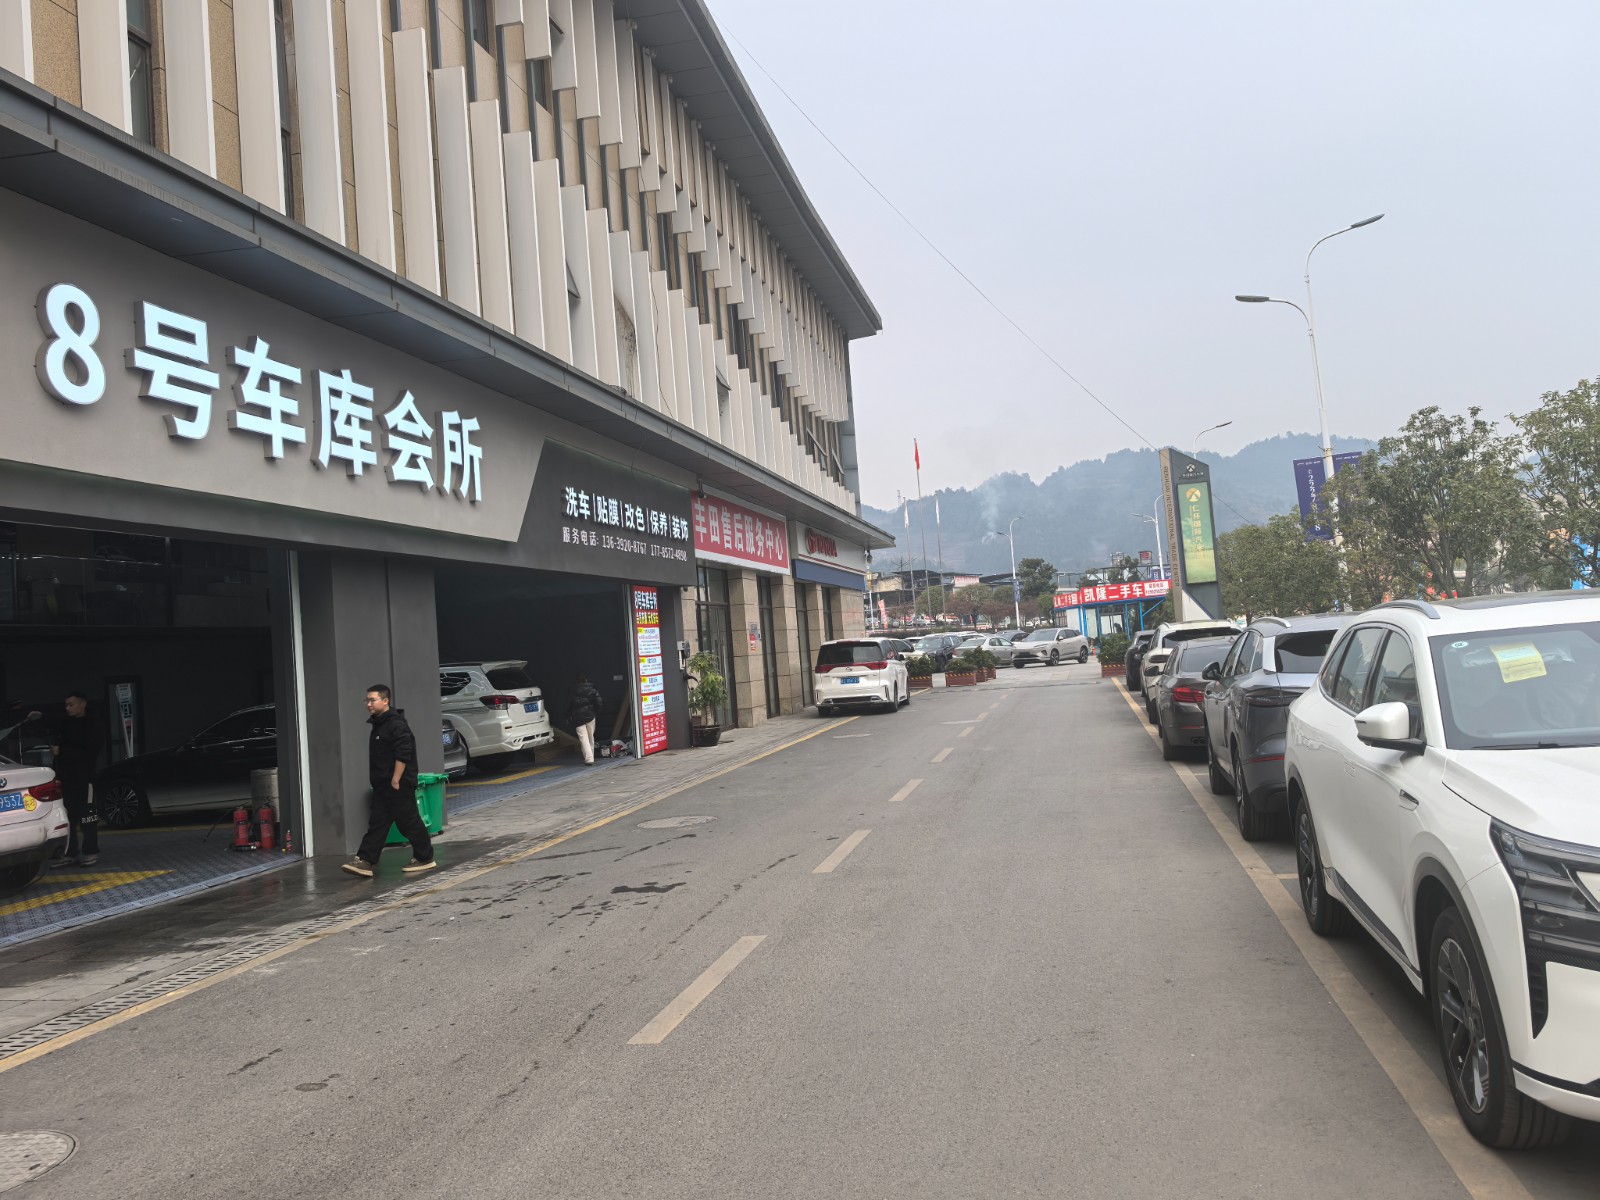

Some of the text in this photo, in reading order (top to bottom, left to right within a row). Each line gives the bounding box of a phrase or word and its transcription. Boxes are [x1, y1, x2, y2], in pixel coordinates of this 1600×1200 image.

[37, 282, 483, 503] 8号车库会所
[694, 499, 785, 562] 丰田售后服务中心
[1084, 583, 1144, 602] 凯隆二手车
